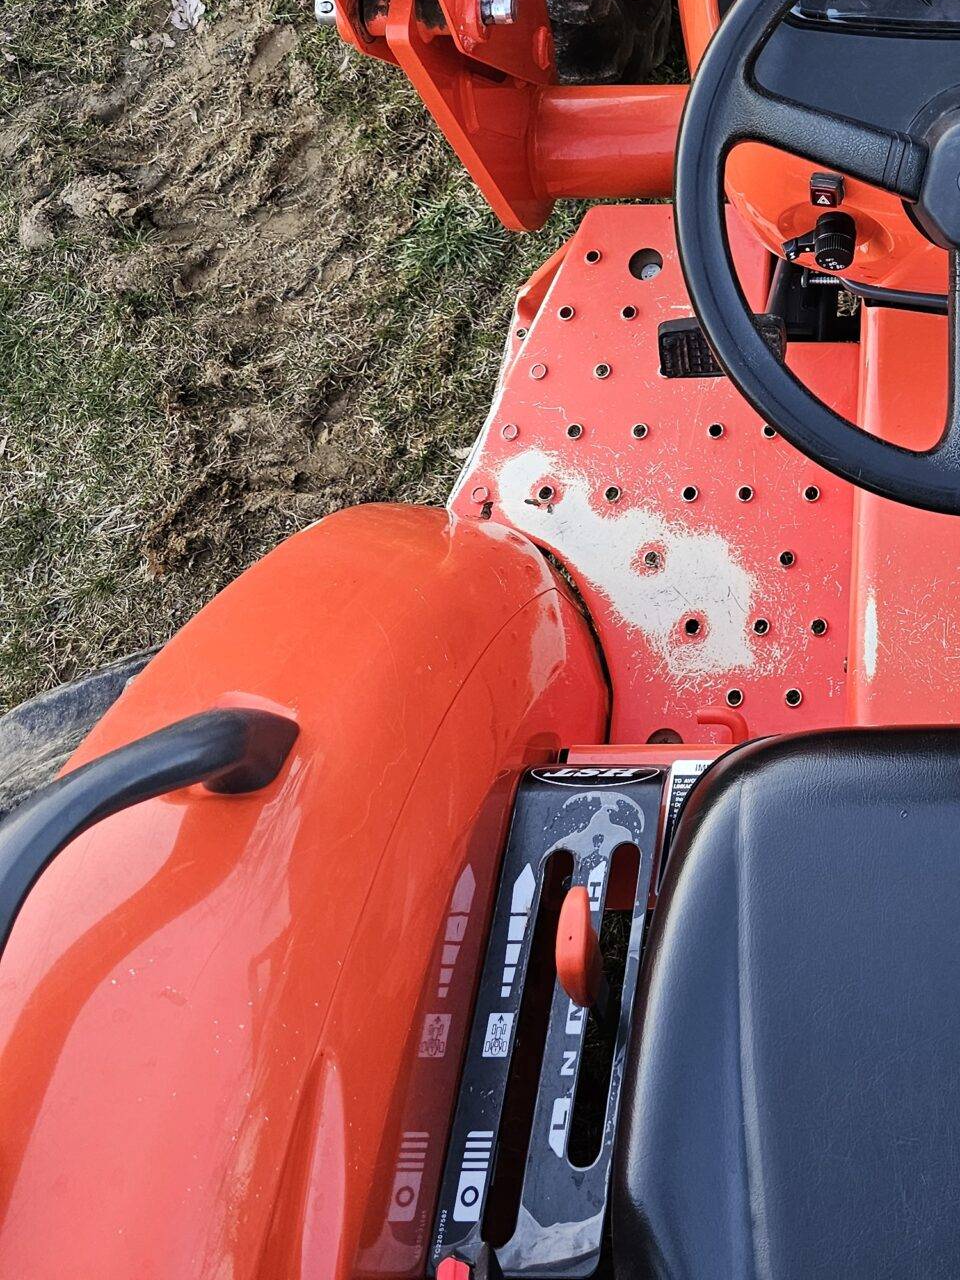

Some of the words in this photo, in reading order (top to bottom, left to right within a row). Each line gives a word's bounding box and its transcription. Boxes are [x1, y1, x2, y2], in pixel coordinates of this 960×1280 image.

[543, 768, 638, 778] HST
[588, 881, 601, 902] H
[560, 1051, 578, 1076] N
[552, 1110, 569, 1131] L
